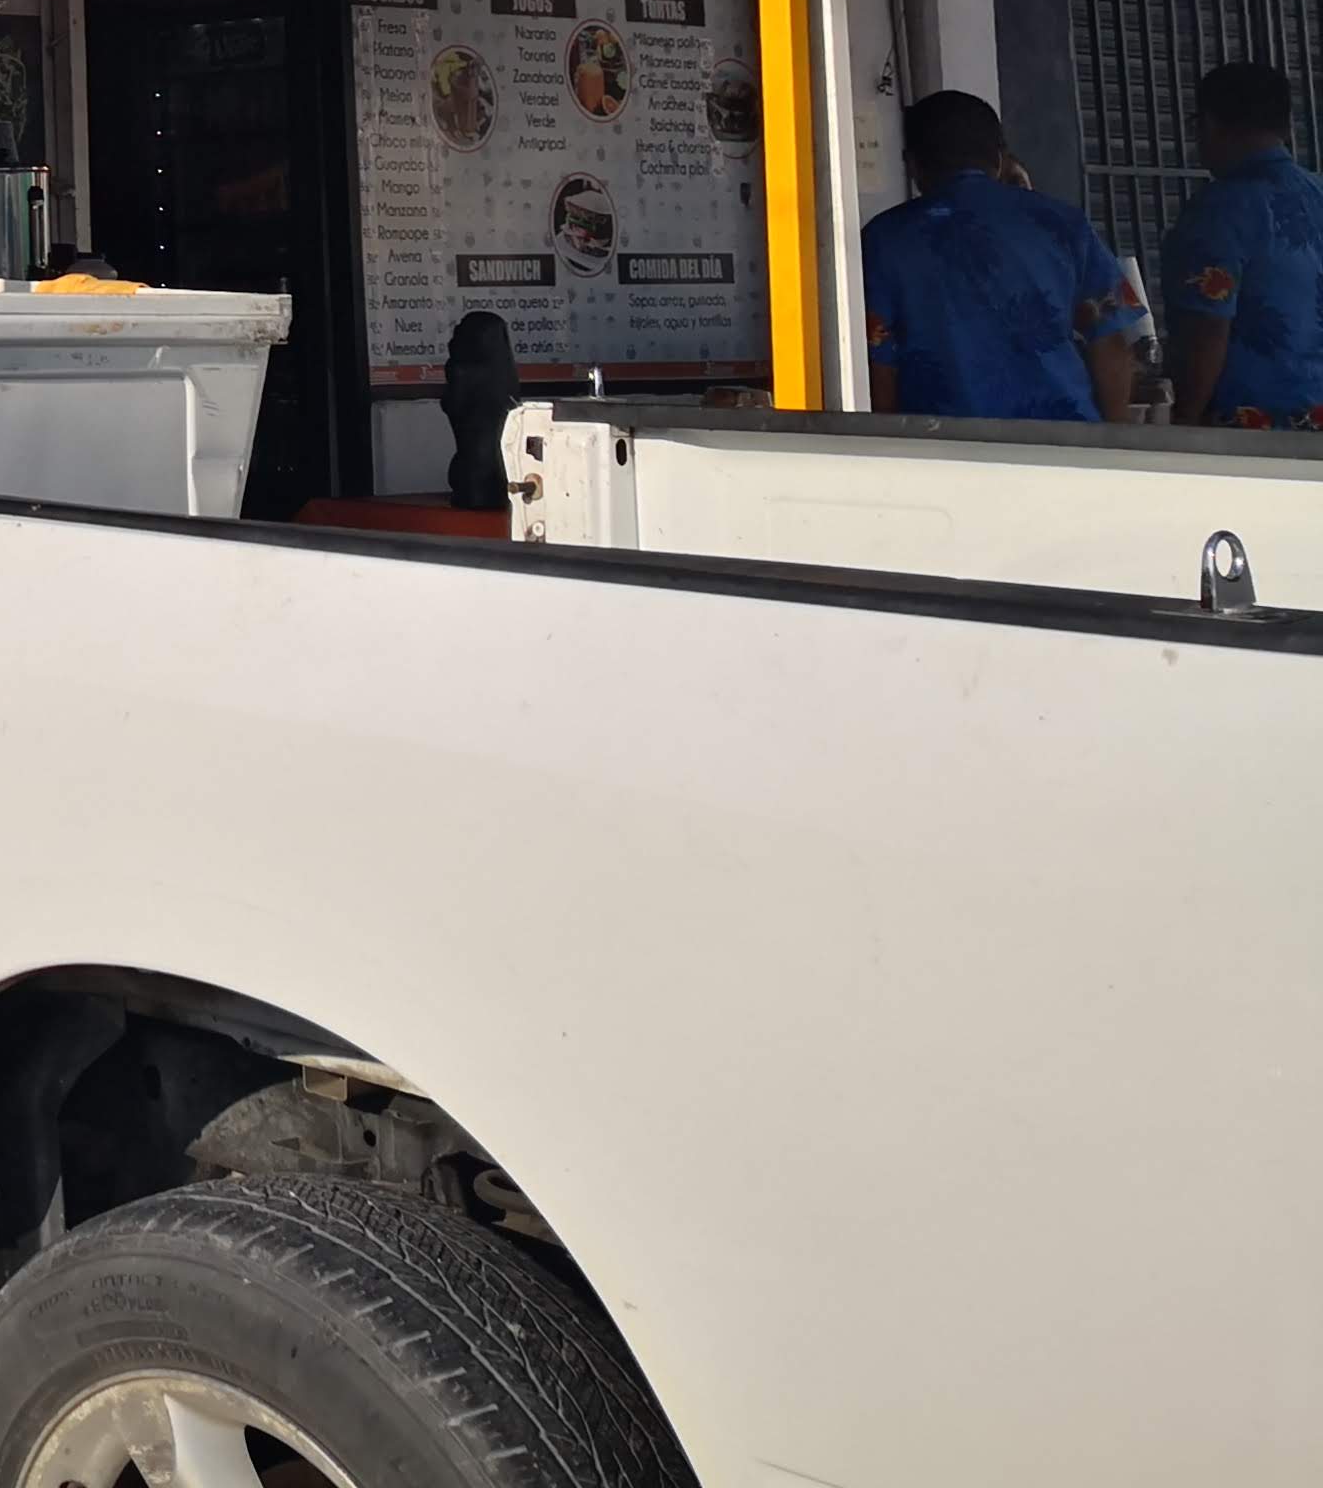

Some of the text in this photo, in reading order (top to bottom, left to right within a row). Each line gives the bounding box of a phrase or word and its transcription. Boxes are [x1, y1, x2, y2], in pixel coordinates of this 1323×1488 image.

[388, 250, 423, 263] Avena
[468, 259, 541, 282] SANDWICH
[629, 253, 724, 279] COMIDA DEL DÍA
[384, 272, 429, 286] Granola
[496, 298, 516, 309] con
[395, 318, 423, 332] Nuez
[386, 342, 435, 356] Almendra
